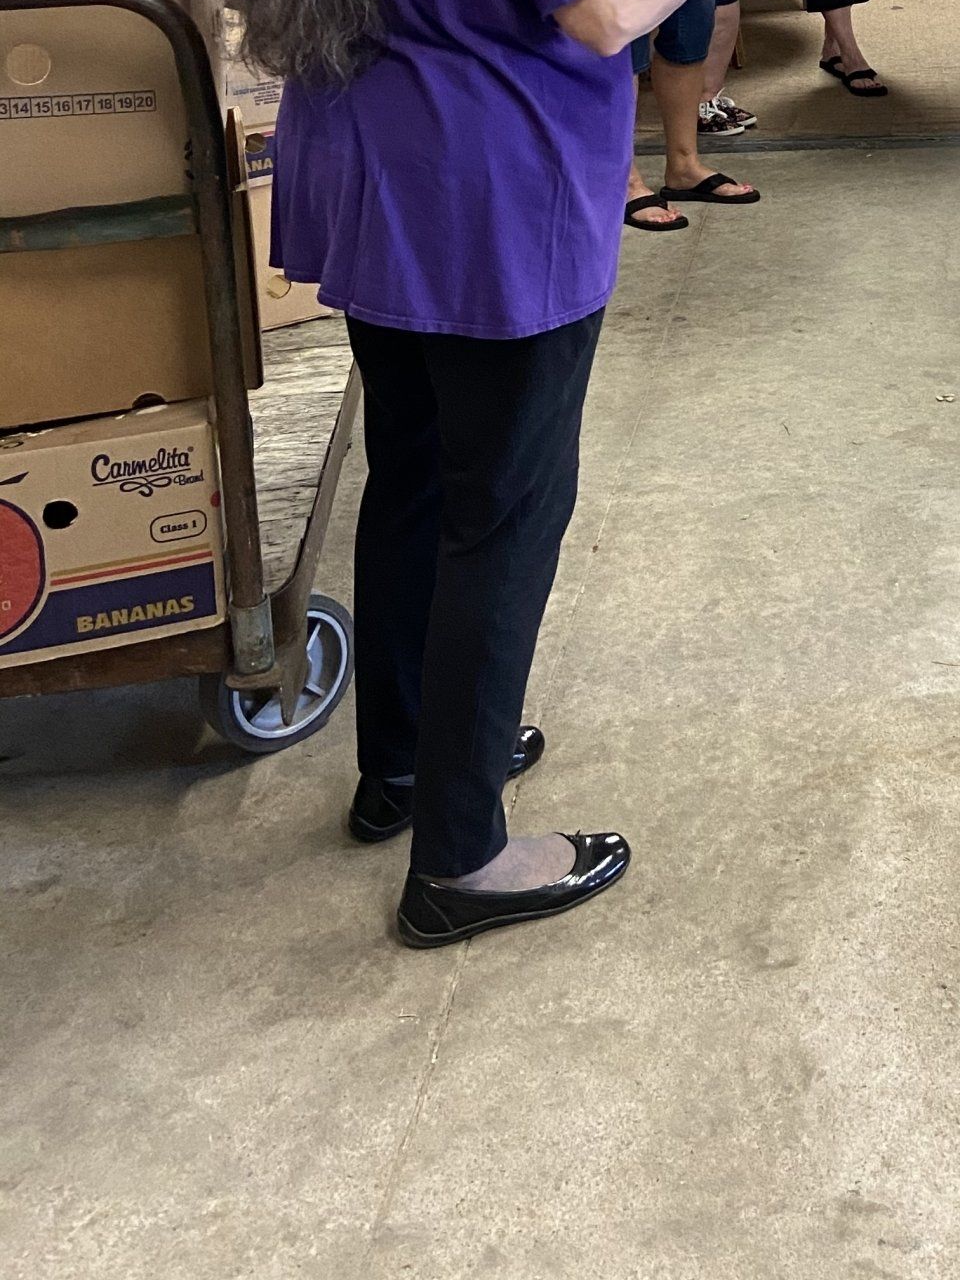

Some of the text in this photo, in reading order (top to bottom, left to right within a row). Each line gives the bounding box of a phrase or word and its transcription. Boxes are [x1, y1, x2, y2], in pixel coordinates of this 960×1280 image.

[0, 96, 153, 115] 3 14 15 16 17 18 19 20
[91, 447, 192, 482] Carmelita
[160, 519, 197, 534] Class 1
[76, 595, 195, 633] BANANAS
